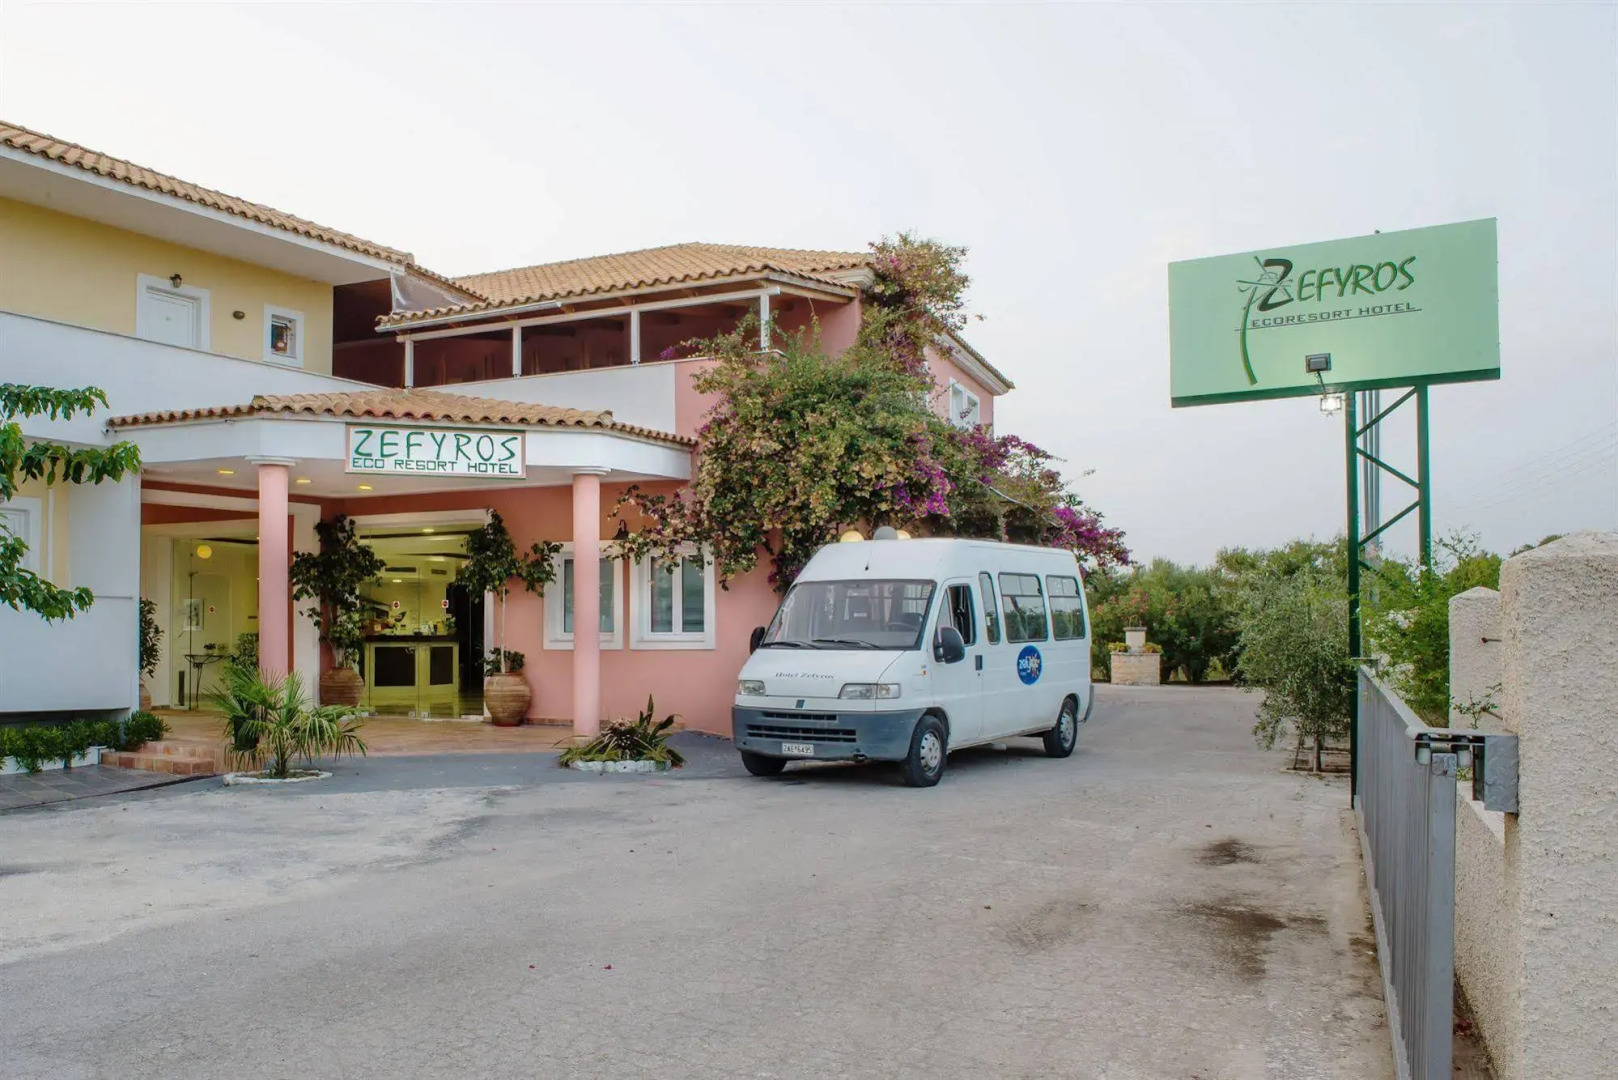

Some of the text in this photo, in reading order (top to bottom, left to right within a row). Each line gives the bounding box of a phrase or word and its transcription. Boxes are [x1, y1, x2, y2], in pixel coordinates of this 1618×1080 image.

[1257, 256, 1416, 312] ZEFYROS
[1251, 301, 1416, 328] ECORESORT HOTEL
[354, 429, 518, 462] ZEFYROS
[352, 457, 519, 474] ECO RESORT HOTEL
